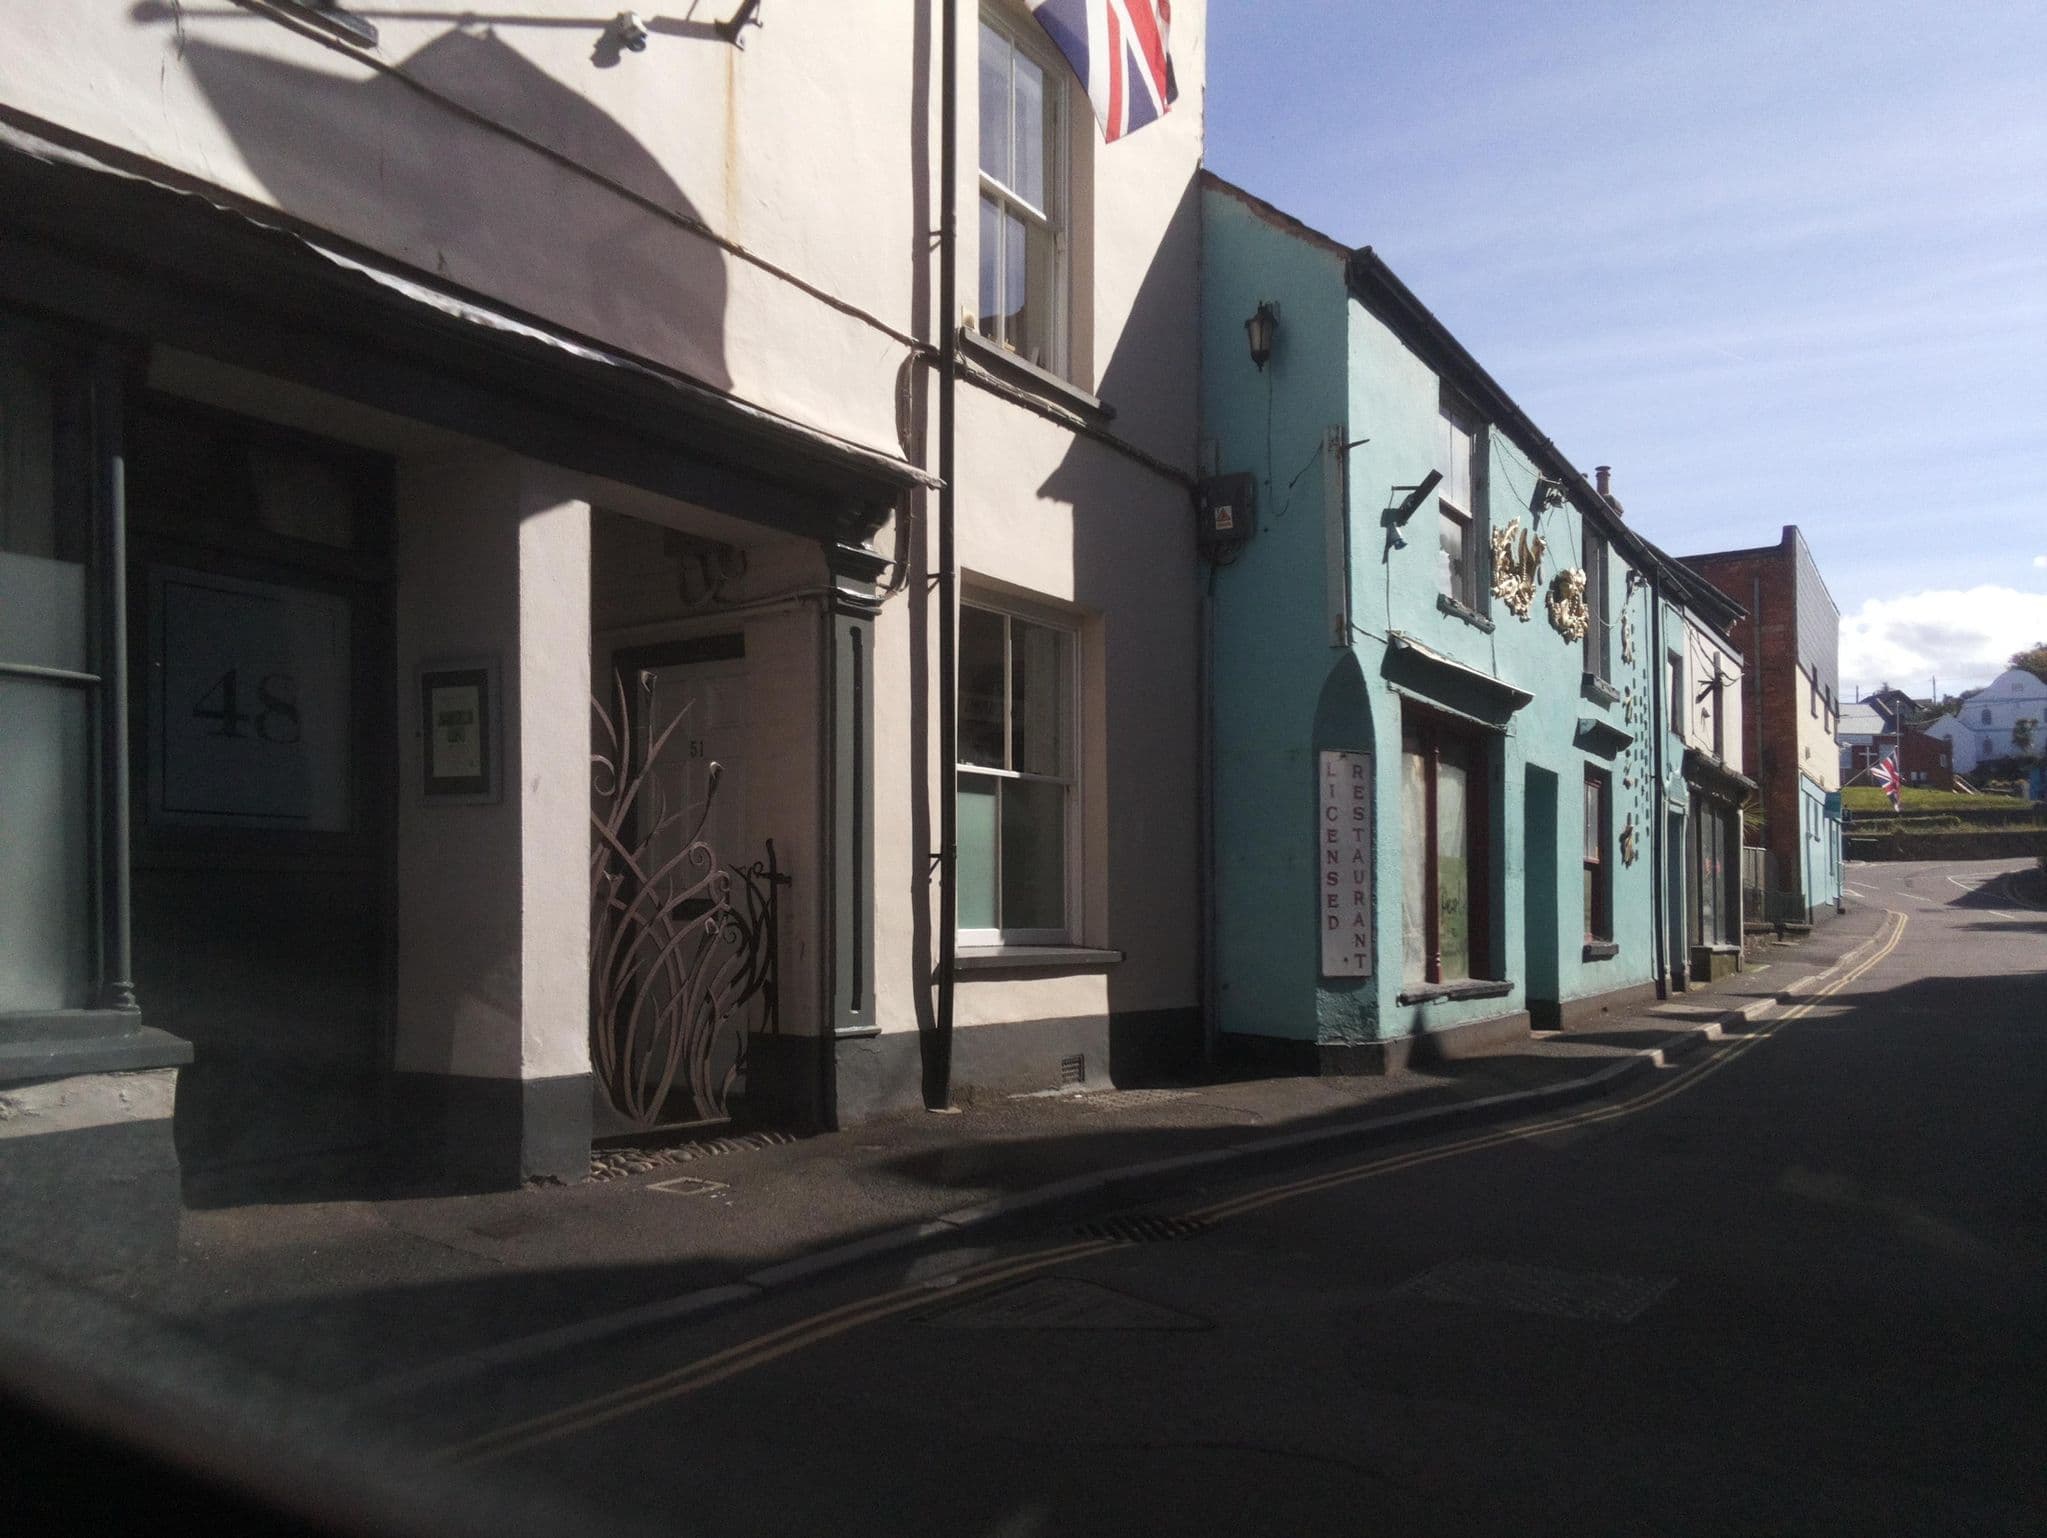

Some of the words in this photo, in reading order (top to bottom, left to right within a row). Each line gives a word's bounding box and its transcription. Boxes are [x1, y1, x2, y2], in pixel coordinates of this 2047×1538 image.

[192, 669, 301, 744] 48
[690, 740, 704, 758] 51
[1326, 763, 1340, 930] LICENSED
[1352, 765, 1367, 969] RESTAURANT
